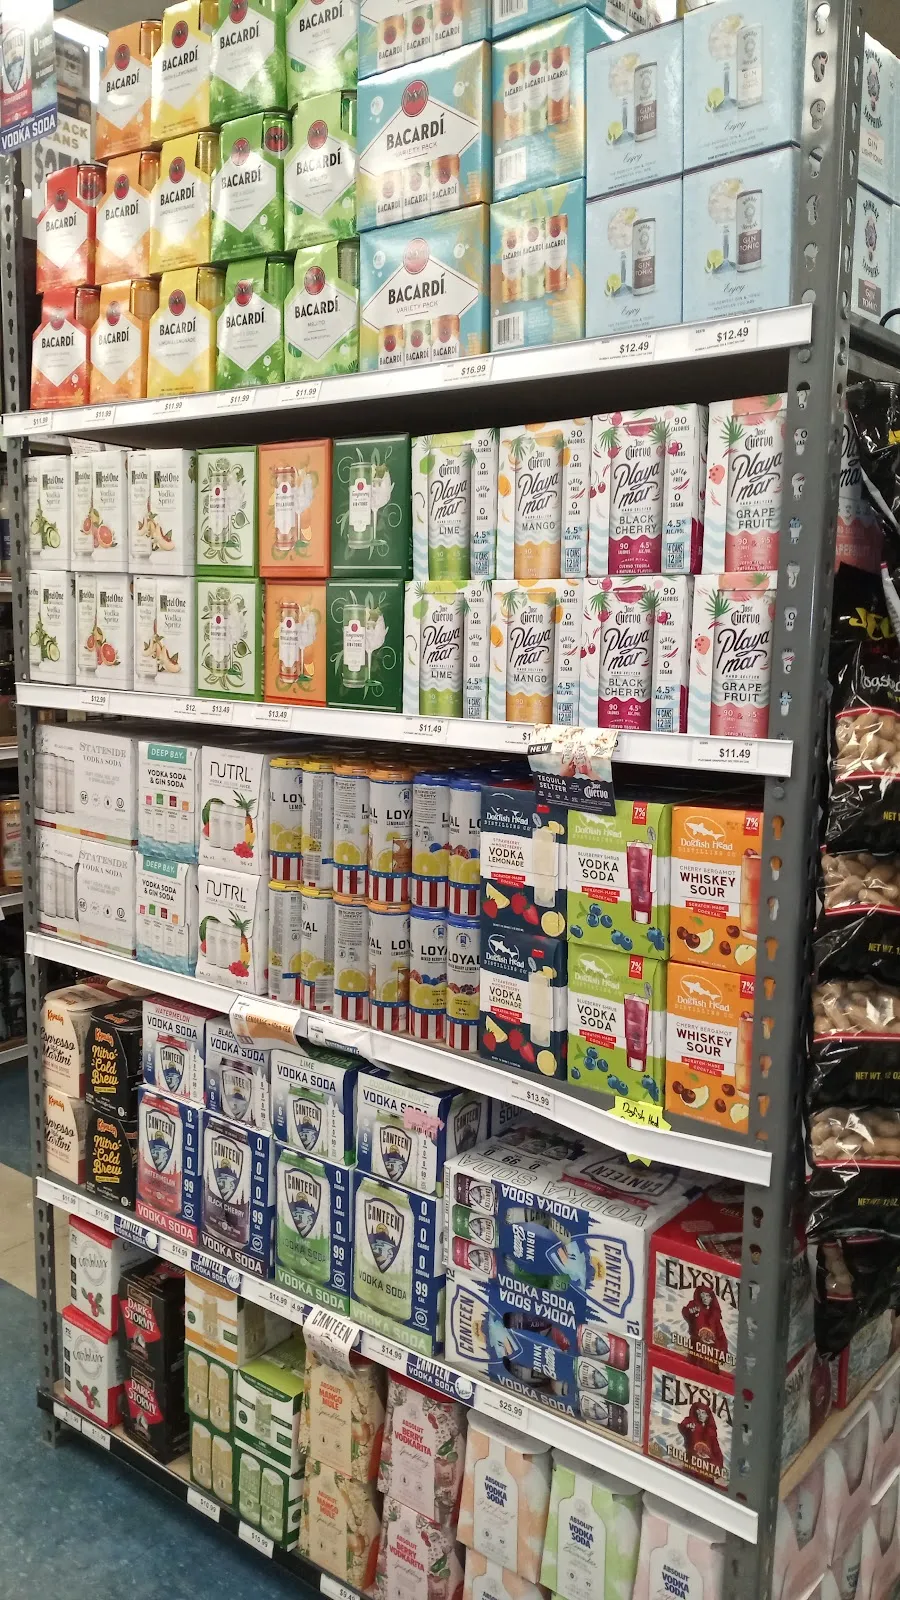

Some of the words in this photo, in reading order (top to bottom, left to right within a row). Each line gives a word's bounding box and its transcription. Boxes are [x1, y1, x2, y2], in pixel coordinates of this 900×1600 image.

[299, 5, 344, 32] BACARDÍ
[220, 25, 260, 49] BACARDÍ
[162, 45, 199, 72] BACARDÍ
[107, 71, 140, 92] BACARDÍ
[0, 127, 31, 150] VODKA
[32, 117, 56, 138] SODA
[387, 113, 446, 150] BACARDÍ
[724, 119, 747, 133] Enjoy
[422, 141, 438, 150] PACK
[296, 150, 342, 175] BACARDÍ
[623, 151, 643, 164] Enjoy
[221, 166, 261, 189] BACARDÍ
[742, 236, 757, 245] GIN
[638, 260, 652, 269] GIN
[636, 268, 653, 277] TONIC
[388, 272, 446, 304] BACARDÍ
[295, 296, 340, 318] BACARDÍ
[396, 304, 420, 314] VARIETY
[422, 301, 438, 309] PACK
[226, 308, 265, 328] BACARDÍ
[159, 317, 196, 336] BACARDÍ
[42, 333, 74, 349] BACARDÍ
[98, 327, 129, 345] BACARDÍ
[717, 327, 749, 342] $12.49
[620, 342, 649, 354] $12.49
[461, 365, 486, 375] $16.99
[230, 394, 249, 404] $11.99
[296, 388, 317, 397] $11.99
[477, 439, 488, 447] 90
[745, 435, 773, 450] Cuervo
[731, 453, 783, 497] Playa
[613, 462, 660, 504] Playa
[430, 477, 468, 514] Playa
[619, 515, 654, 524] BLACK
[736, 508, 775, 519] GRAPE
[439, 526, 460, 535] LIME
[522, 521, 555, 531] MANGO
[616, 524, 657, 535] CHERRY
[738, 519, 772, 529] FRUIT
[175, 598, 186, 607] One
[616, 611, 641, 625] Cuervo
[731, 611, 760, 625] Cuervo
[514, 673, 547, 683] MANGO
[608, 679, 643, 688] BLACK
[605, 688, 647, 698] CHERRY
[722, 682, 762, 692] GRAPE
[91, 695, 106, 703] $12.99
[724, 692, 759, 702] FRUIT
[212, 705, 230, 714] $13.49
[268, 710, 287, 719] $13.49
[419, 724, 442, 733] $11.49
[80, 742, 127, 758] STATESIDE
[152, 748, 168, 758] DEEP
[719, 749, 751, 758] $11.49
[148, 769, 168, 779] VODKA
[170, 772, 186, 780] SODA
[538, 775, 566, 786] TEQUILA
[540, 783, 567, 792] SELTZER
[584, 786, 608, 798] Cuervo
[634, 807, 645, 817] 7%
[575, 825, 602, 836] Dogfish
[604, 827, 622, 838] Head
[681, 838, 710, 849] Dogfish
[712, 839, 733, 850] Head
[489, 847, 524, 861] VODKA
[489, 855, 524, 867] LEMONADE
[578, 858, 619, 873] VODKA
[680, 865, 701, 874] CHERRY
[703, 867, 736, 876] BERGAMOT
[582, 869, 615, 882] SODA
[680, 872, 735, 887] WHISKEY
[142, 879, 161, 891] VODKA
[162, 885, 176, 894] SODA
[690, 885, 725, 898] SOUR
[697, 909, 722, 918] COCKTAIL
[489, 986, 522, 1002] VODKA
[489, 996, 522, 1010] LEMONADE
[155, 1007, 190, 1023] WATERMELON
[577, 1005, 616, 1023] VODKA
[147, 1015, 174, 1034] VODKA
[176, 1023, 197, 1039] SODA
[580, 1016, 612, 1032] SODA
[676, 1029, 732, 1048] WHISKEY
[92, 1045, 115, 1060] Nitro
[686, 1042, 721, 1056] SOUR
[96, 1059, 117, 1074] Cold
[91, 1071, 119, 1085] Brew
[277, 1064, 308, 1083] VODKA
[310, 1075, 336, 1092] SODA
[855, 1071, 868, 1080] NET
[363, 1090, 397, 1111] VODKA
[527, 1091, 549, 1105] $13.99
[94, 1135, 118, 1151] Nitro
[382, 1130, 409, 1151] CANTEEN
[97, 1148, 120, 1165] Cold
[93, 1159, 122, 1175] Brew
[287, 1176, 318, 1200] CANTEEN
[223, 1201, 245, 1217] CHERRY
[252, 1209, 263, 1223] 99
[137, 1205, 167, 1228] VODKA
[169, 1220, 193, 1240] SODA
[367, 1204, 401, 1231] CANTEEN
[203, 1234, 233, 1257] VODKA
[235, 1248, 262, 1273] SODA
[334, 1245, 344, 1259] 99
[526, 1231, 536, 1261] DRINK
[277, 1270, 314, 1294] VODKA
[315, 1289, 345, 1312] SODA
[416, 1281, 428, 1297] 99
[498, 1274, 538, 1300] VODKA
[541, 1292, 576, 1315] SODA
[312, 1311, 353, 1344] CANTEEN
[671, 1332, 693, 1350] FULL
[381, 1344, 402, 1360] $14.99
[319, 1389, 343, 1405] MANGO
[499, 1400, 523, 1417] $25.99
[402, 1420, 424, 1433] ABSOLUT
[402, 1427, 423, 1443] BERRY
[395, 1431, 431, 1456] VODKARITA
[485, 1476, 507, 1491] ABSOLUT
[484, 1482, 507, 1501] VODKA
[486, 1491, 504, 1508] SODA
[570, 1515, 593, 1532] ABSOLUT
[569, 1523, 594, 1542] VODKA
[571, 1533, 591, 1549] SODA
[389, 1546, 424, 1571] VODKARITA
[663, 1564, 689, 1582] ABSOLUT
[662, 1573, 689, 1593] VODKA
